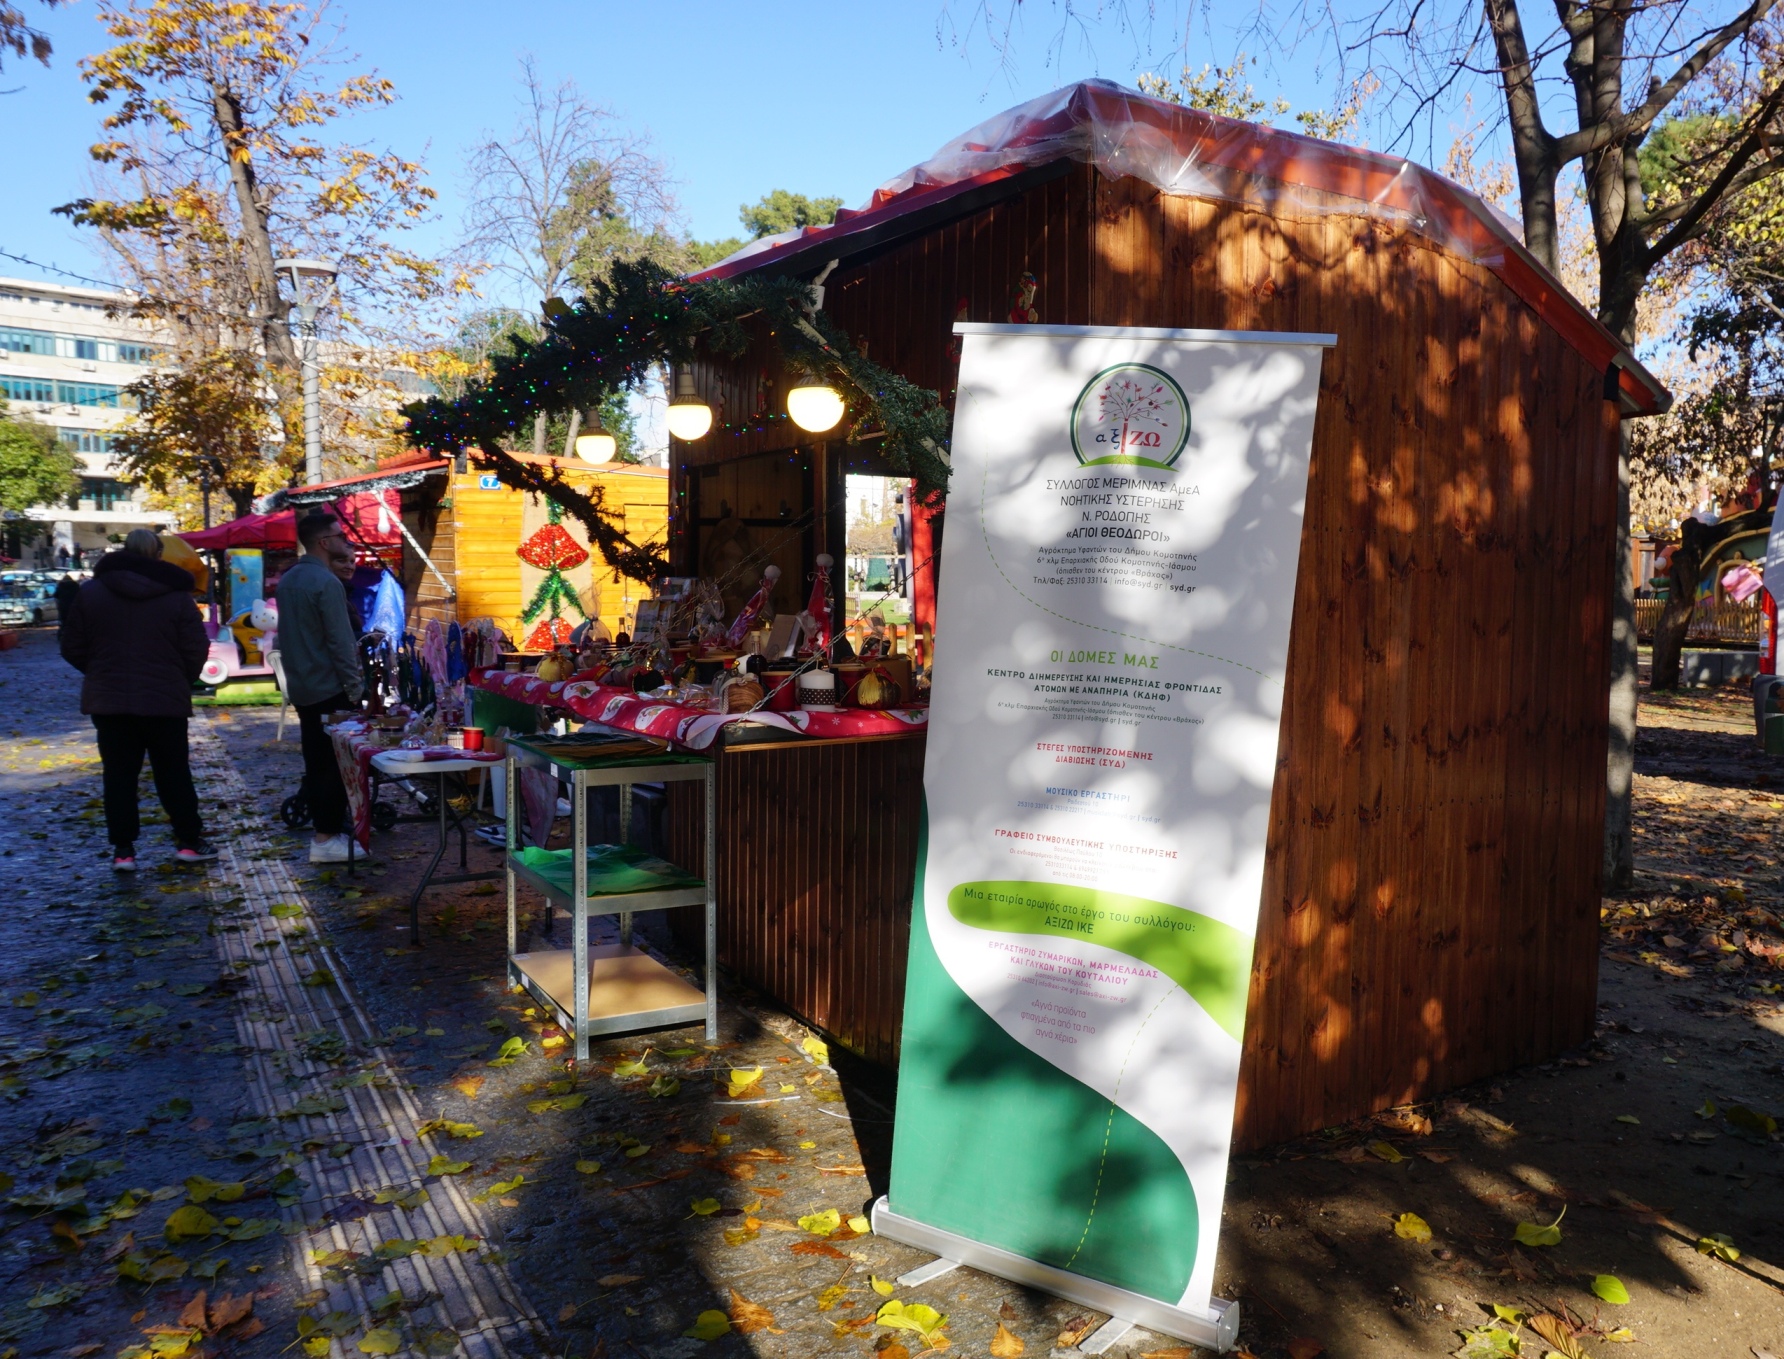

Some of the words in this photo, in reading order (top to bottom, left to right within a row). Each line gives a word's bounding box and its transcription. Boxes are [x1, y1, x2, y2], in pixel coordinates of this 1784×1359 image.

[486, 477, 495, 487] 7
[1046, 478, 1100, 490] ΣΥΛΛΟΓΟΣ
[1102, 478, 1167, 492] ΜΕΡΙΜΝΑΣ
[1170, 483, 1200, 496] ΑμεΑ
[1060, 494, 1113, 506] ΝΟΗΤΙΚΗΣ
[1116, 495, 1185, 511] ΥΣΤΕΡΗΣΗΣ
[1082, 511, 1092, 521] Ν.
[1095, 510, 1151, 524] ΡΟΔΟΠΗΣ
[1066, 527, 1098, 538] «ΑΓΙΟΙ
[1101, 527, 1171, 542] ΘΕΟΔΩΡΟΙ»
[1038, 546, 1076, 555] Αγρόκτημα
[1124, 547, 1151, 557] Δήμου
[1153, 550, 1198, 562] Κομοτηνής
[1046, 557, 1059, 566] χλμ
[1061, 556, 1098, 565] Επαρχιακής
[1099, 556, 1119, 564] Οδού
[1097, 567, 1129, 576] κέντρου
[1131, 569, 1173, 581] «Βράχος»)
[1066, 576, 1086, 584] 25310
[1087, 576, 1108, 584] 33114
[1114, 578, 1163, 590] info@syd.gr
[1169, 584, 1196, 594] syd.gr
[1050, 650, 1063, 663] ΟΙ
[1068, 650, 1117, 665] ΔΟΜΕΣ
[1124, 653, 1160, 669] ΜΑΣ
[987, 668, 1025, 679] ΚΕΝΤΡΟ
[1028, 672, 1084, 682] ΔΙΗΜΕΡΕΥΣΗΣ
[1086, 674, 1101, 683] ΚΑΙ
[1104, 675, 1161, 689] ΗΜΕΡΗΣΙΑΣ
[1164, 682, 1222, 695] ΦΡΟΝΤΙΔΑΣ
[1034, 684, 1067, 693] ΑΤΟΜΩΝ
[1069, 685, 1080, 694] ΜΕ
[1082, 686, 1129, 697] ΑΝΑΠΗΡΙΑ
[1133, 690, 1171, 703] (ΚΔΗΦ)
[1101, 699, 1121, 708] Δήμου
[1122, 702, 1156, 713] Κομοτηνής
[1121, 718, 1141, 727] syd.gr
[1036, 743, 1064, 752] ΣΤΕΓΕΣ
[1067, 745, 1154, 761] ΥΠΟΣΤΗΡΙΖΟΜΕΝΗΣ
[1055, 756, 1096, 766] ΔΙΑΒΙΩΣΗΣ
[1099, 758, 1126, 769] (ΣΥΔ)
[1045, 786, 1078, 797] ΜΟΥΣΙΚΟ
[1080, 790, 1131, 803] ΕΡΓΑΣΤΗΡΙ
[1141, 816, 1161, 824] syd.gr
[995, 829, 1034, 840] ΓΡΑΦΕΙΟ
[1036, 834, 1105, 850] ΣΥΜΒΟΥΛΕΥΤΙΚΗΣ
[1109, 843, 1178, 859] ΥΠΟΣΤΗΡΙΞΗΣ
[964, 888, 984, 900] Μια
[987, 892, 1024, 907] εταιρία
[1026, 897, 1060, 913] αρωγός
[1062, 905, 1078, 915] στο
[1081, 905, 1105, 921] έργο
[1109, 911, 1130, 923] του
[1134, 915, 1196, 932] συλλόγου:
[1044, 916, 1074, 930] ΑΞΙΖΩ
[1077, 922, 1094, 934] ΙΚΕ
[988, 941, 1036, 956] ΕΡΓΑΣΤΗΡΙΟ
[1037, 950, 1086, 968] ΖΥΜΑΡΙΚΩΝ,
[1089, 960, 1159, 979] ΜΑΡΜΕΛΑΔΑΣ
[1010, 955, 1024, 965] ΚΑΙ
[1025, 959, 1055, 972] ΓΛΥΚΩΝ
[1057, 966, 1073, 976] ΤΟΥ
[1075, 967, 1129, 986] ΚΟΥΤΑΛΙΟΥ
[1031, 998, 1052, 1012] «Αγνά
[1053, 1003, 1087, 1019] προϊόντα
[1020, 1011, 1056, 1026] φτιαγμένα
[1057, 1020, 1071, 1030] από
[1073, 1023, 1082, 1031] τα
[1082, 1025, 1096, 1035] πιο
[1035, 1028, 1053, 1040] αγνά
[1054, 1033, 1078, 1045] χέρια»
